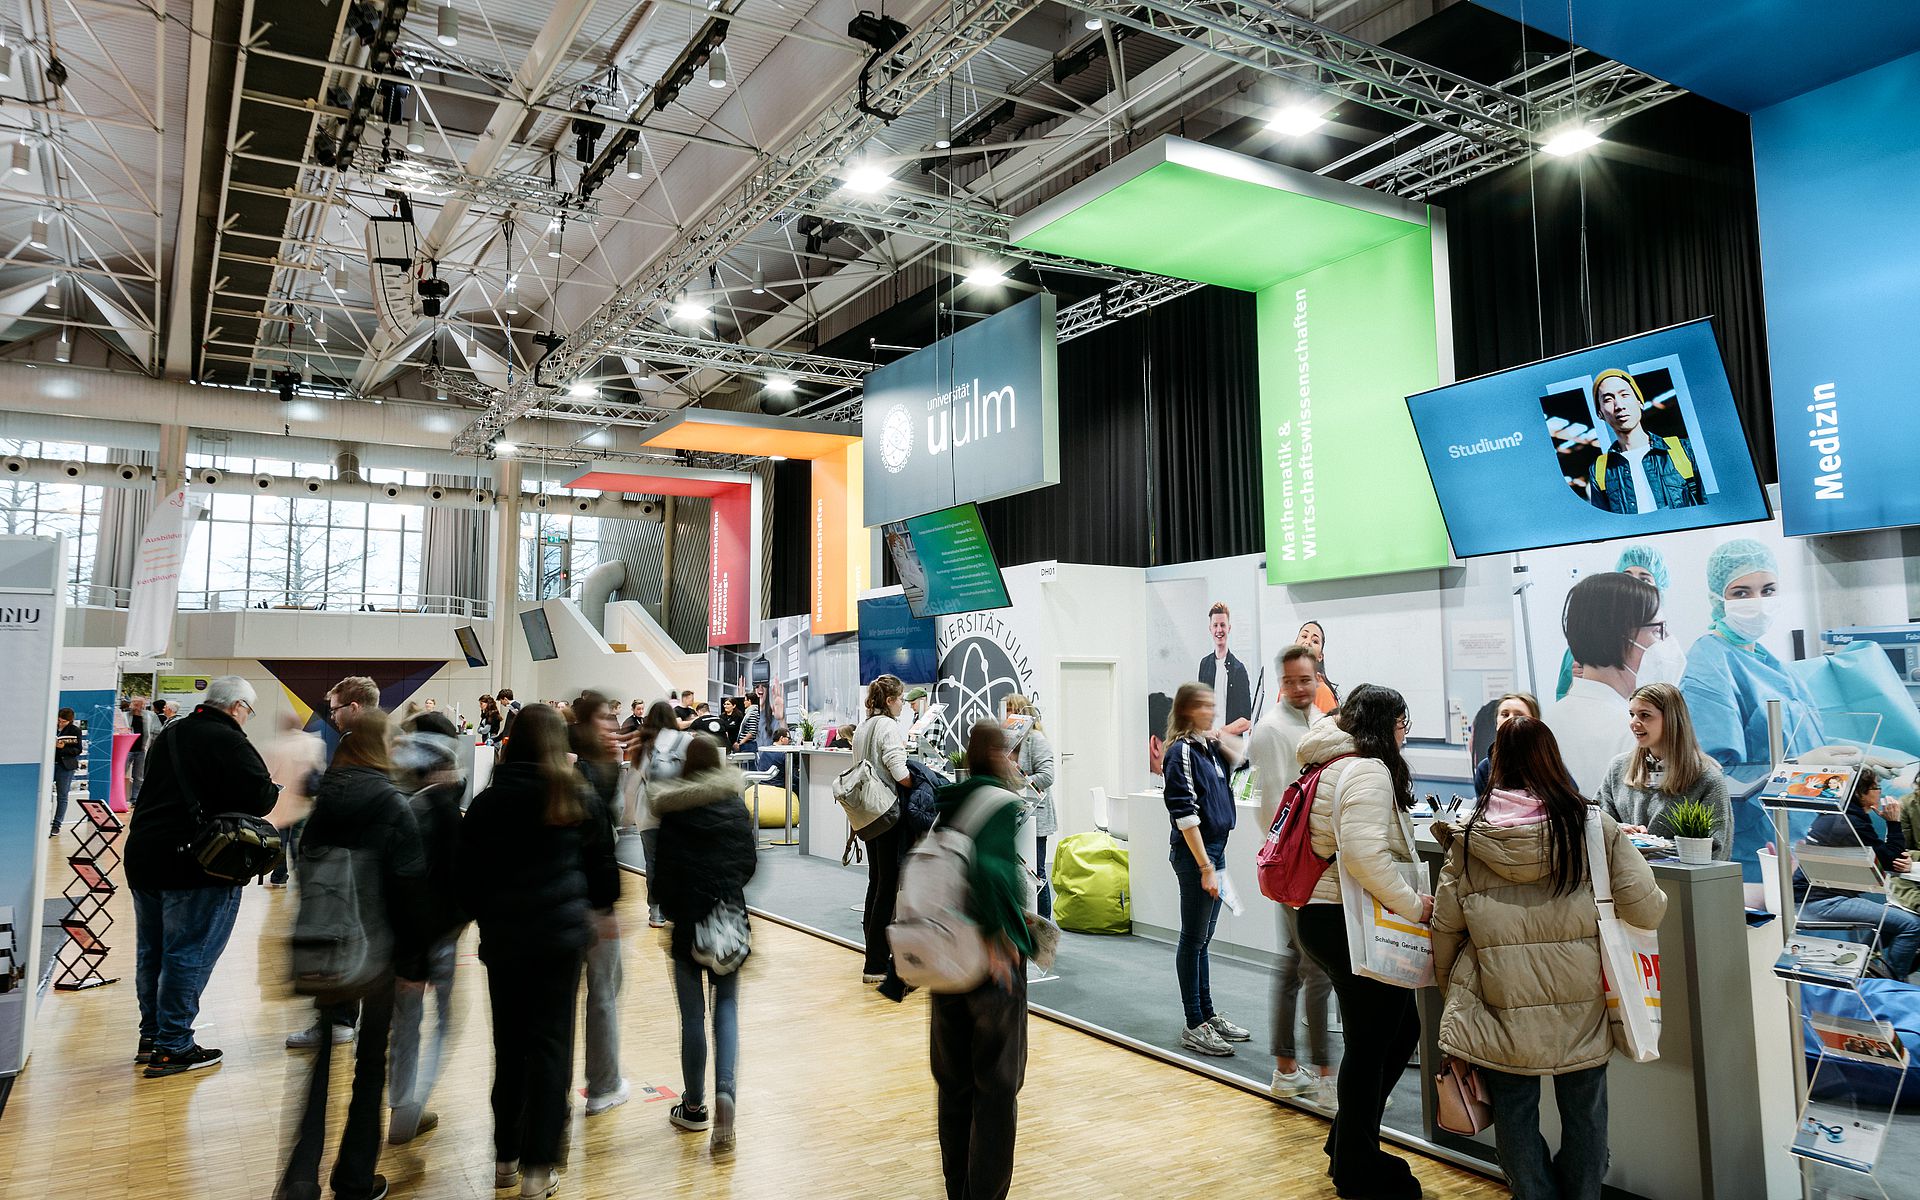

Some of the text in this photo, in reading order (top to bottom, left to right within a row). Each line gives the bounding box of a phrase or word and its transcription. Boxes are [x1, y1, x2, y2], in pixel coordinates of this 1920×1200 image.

[927, 382, 970, 411] universität
[927, 378, 1016, 456] uulm
[1294, 288, 1317, 561] Wirtschaftswissenschaften
[1448, 431, 1523, 459] Studium?
[1807, 382, 1844, 500] Medizin
[1278, 420, 1296, 561] Mathematik &
[711, 511, 719, 635] Ingenieurwissenschaften
[1041, 567, 1055, 576] DH01
[1005, 630, 1032, 682] ULM
[1375, 935, 1400, 948] Schalung
